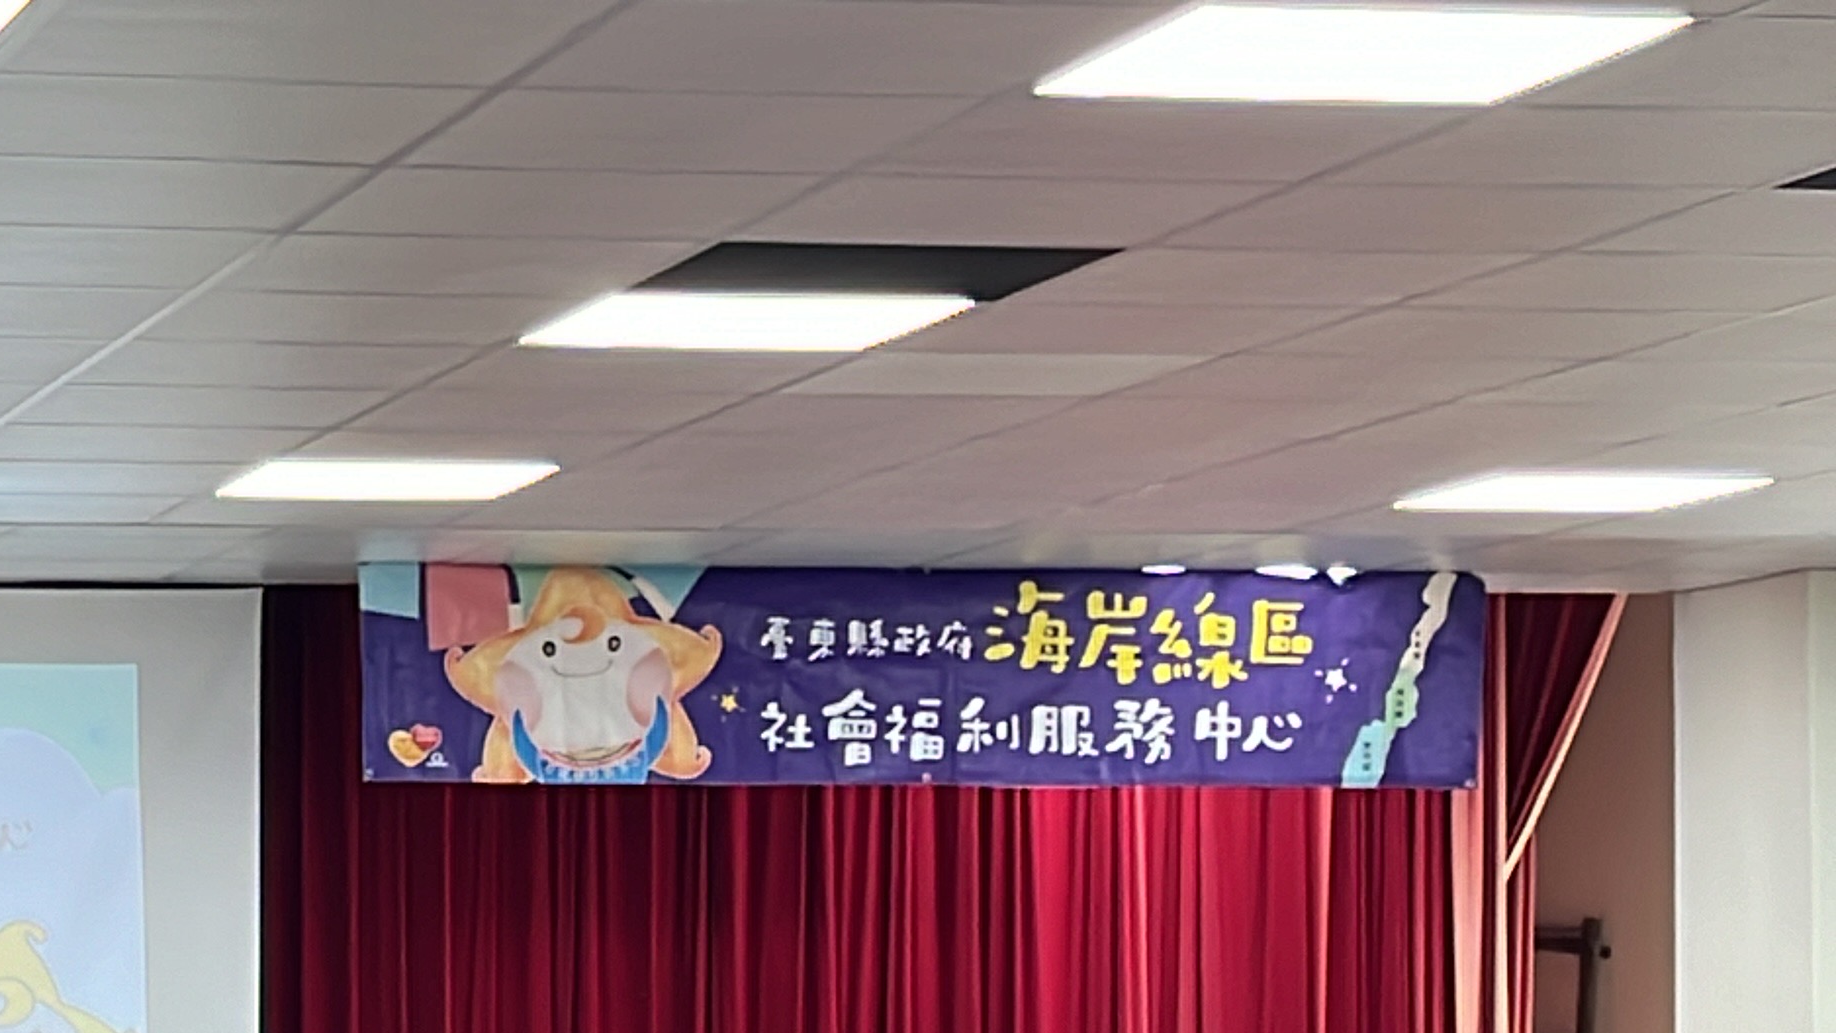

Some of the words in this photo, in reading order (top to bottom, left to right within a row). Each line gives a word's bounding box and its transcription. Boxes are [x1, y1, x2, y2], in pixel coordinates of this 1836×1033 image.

[761, 616, 973, 662] 臺東縣政府
[985, 581, 1313, 689] 海岸線區
[761, 689, 1302, 766] 社會福利服務中心
